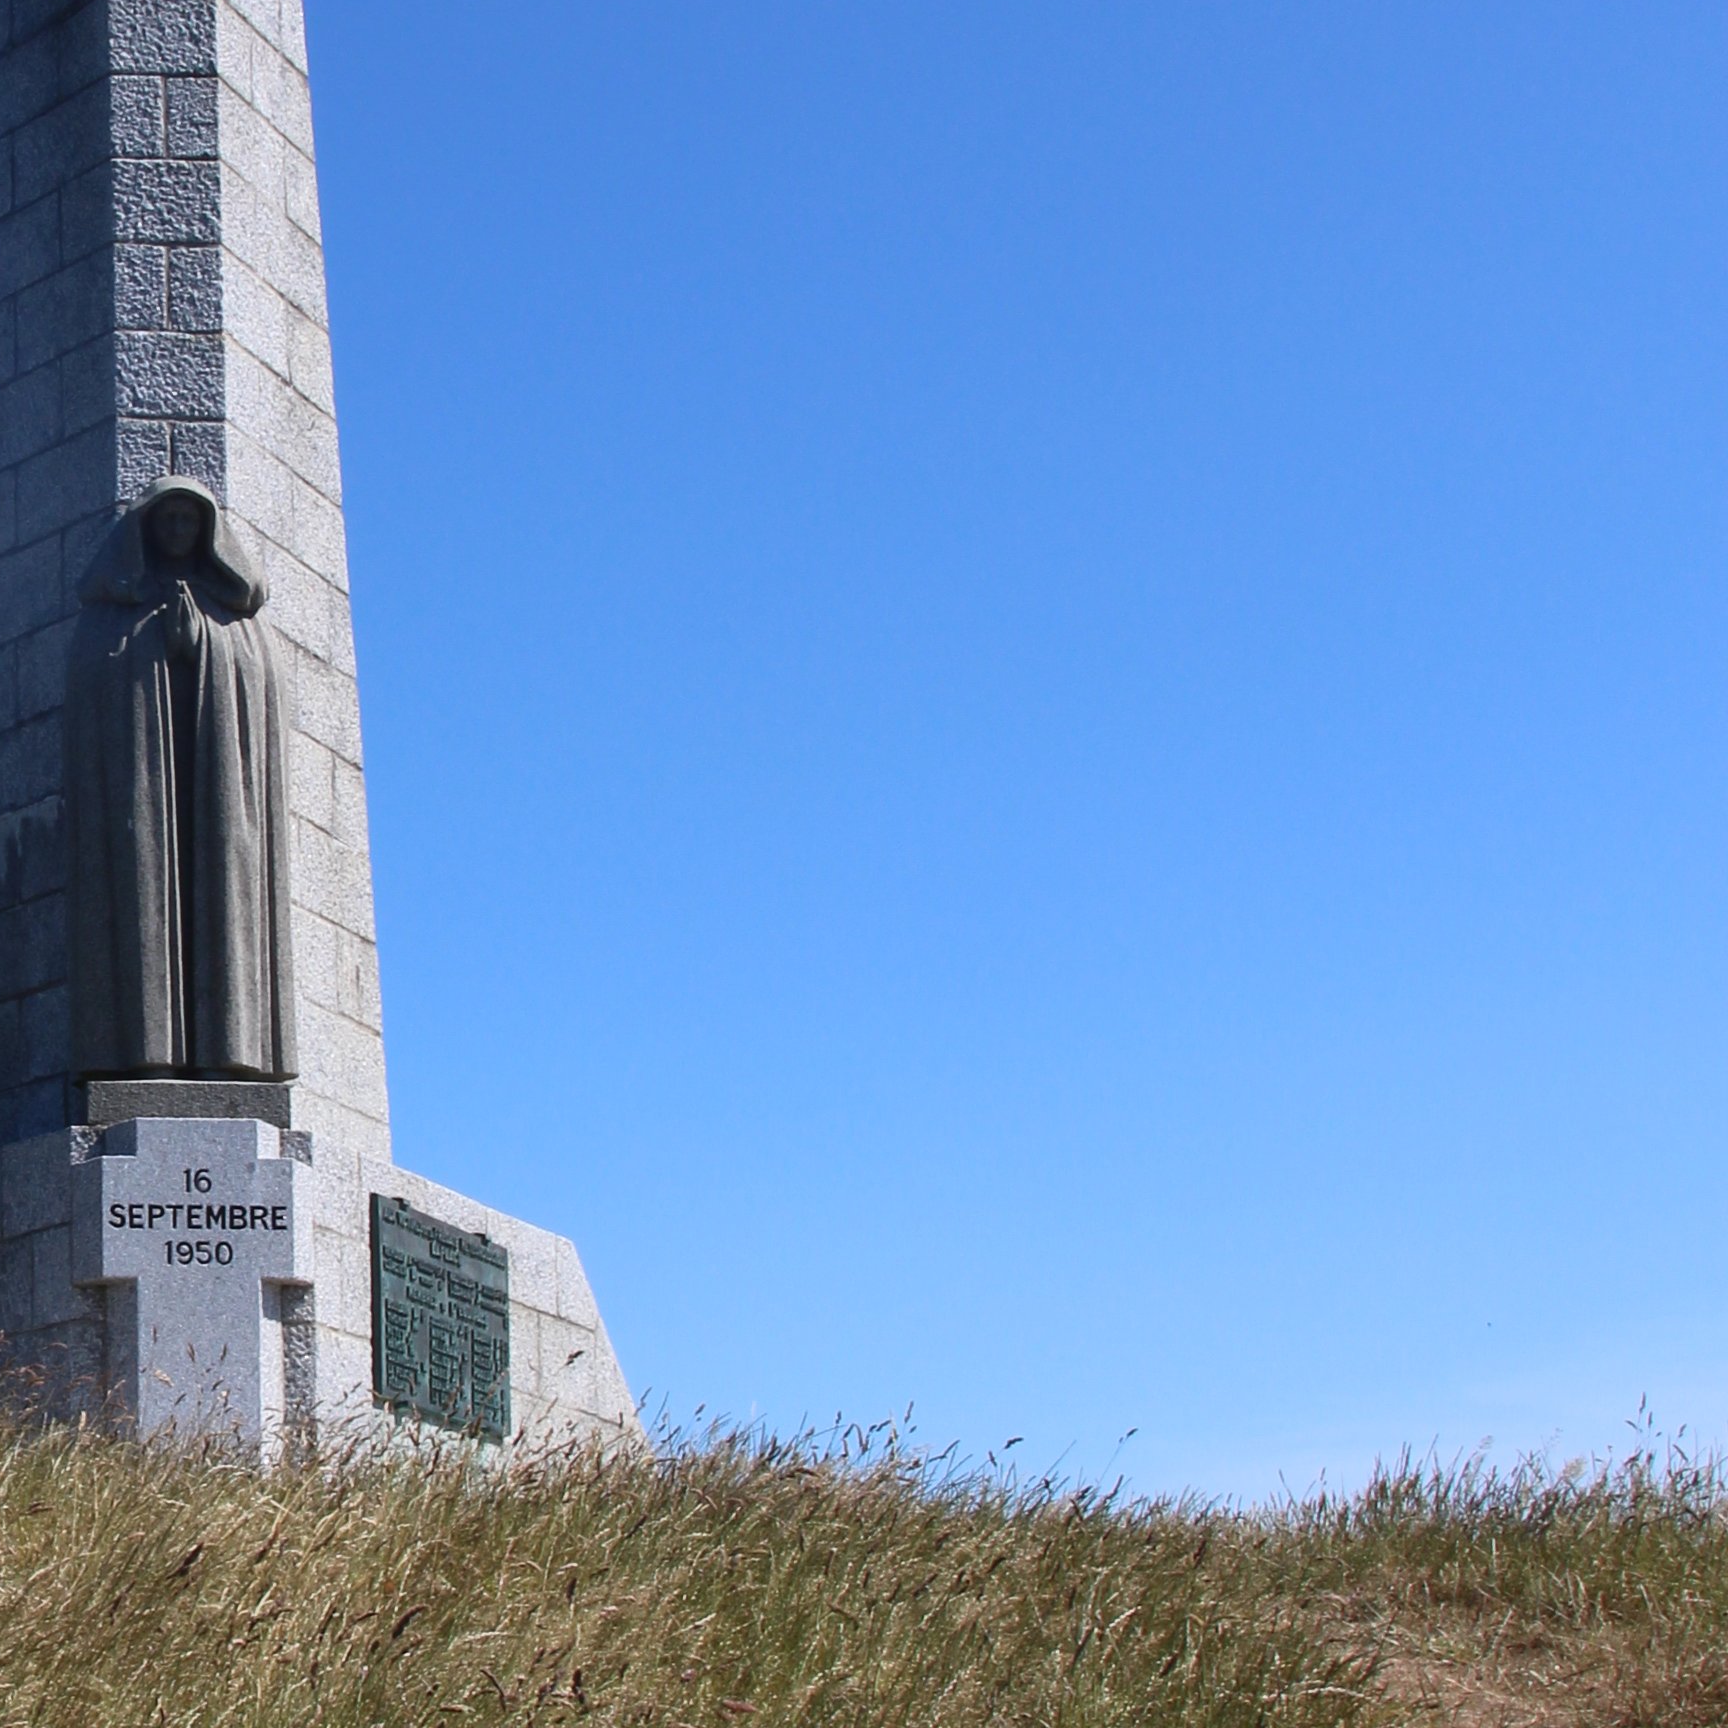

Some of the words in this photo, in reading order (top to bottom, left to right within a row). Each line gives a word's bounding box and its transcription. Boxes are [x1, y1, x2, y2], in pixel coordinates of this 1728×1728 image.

[183, 1168, 212, 1194] 16
[108, 1203, 288, 1231] SEPTEMBRE
[164, 1240, 234, 1266] 1950
